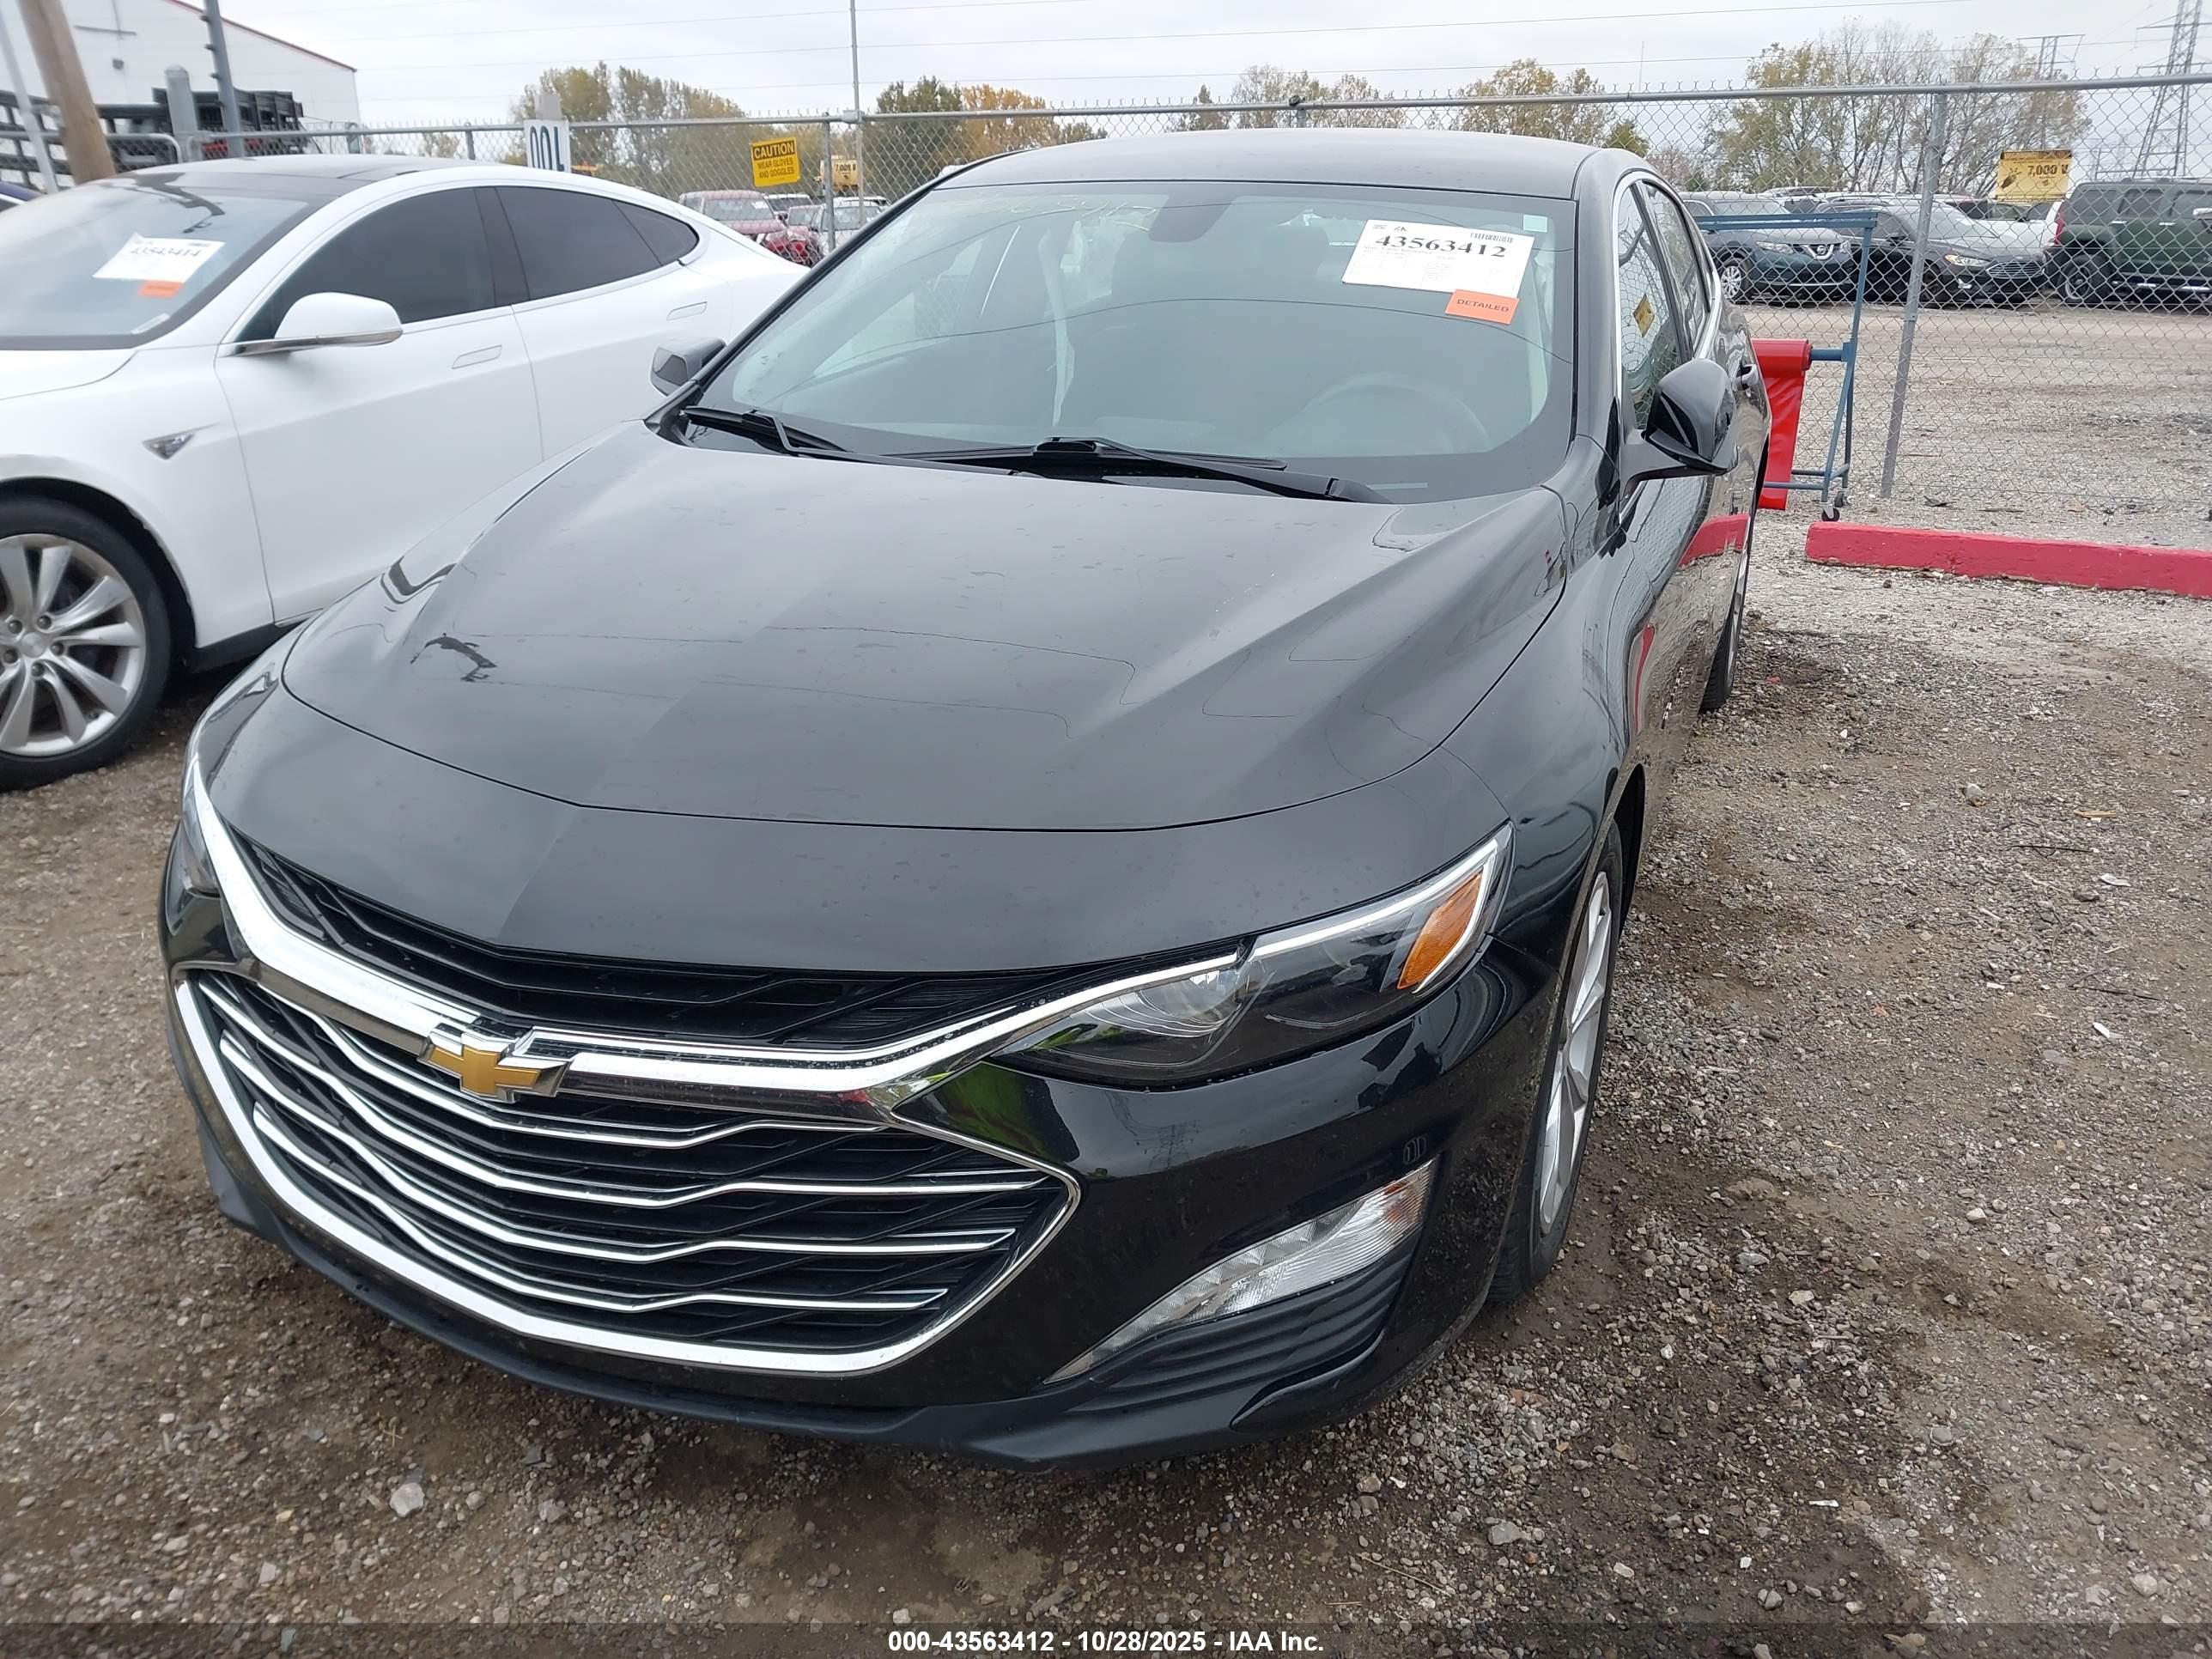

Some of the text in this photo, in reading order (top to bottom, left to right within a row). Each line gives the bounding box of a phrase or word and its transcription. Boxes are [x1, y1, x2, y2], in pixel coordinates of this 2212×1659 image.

[754, 142, 794, 159] CAUTION
[1376, 235, 1507, 258] 43563412
[1456, 299, 1510, 313] DETAILED
